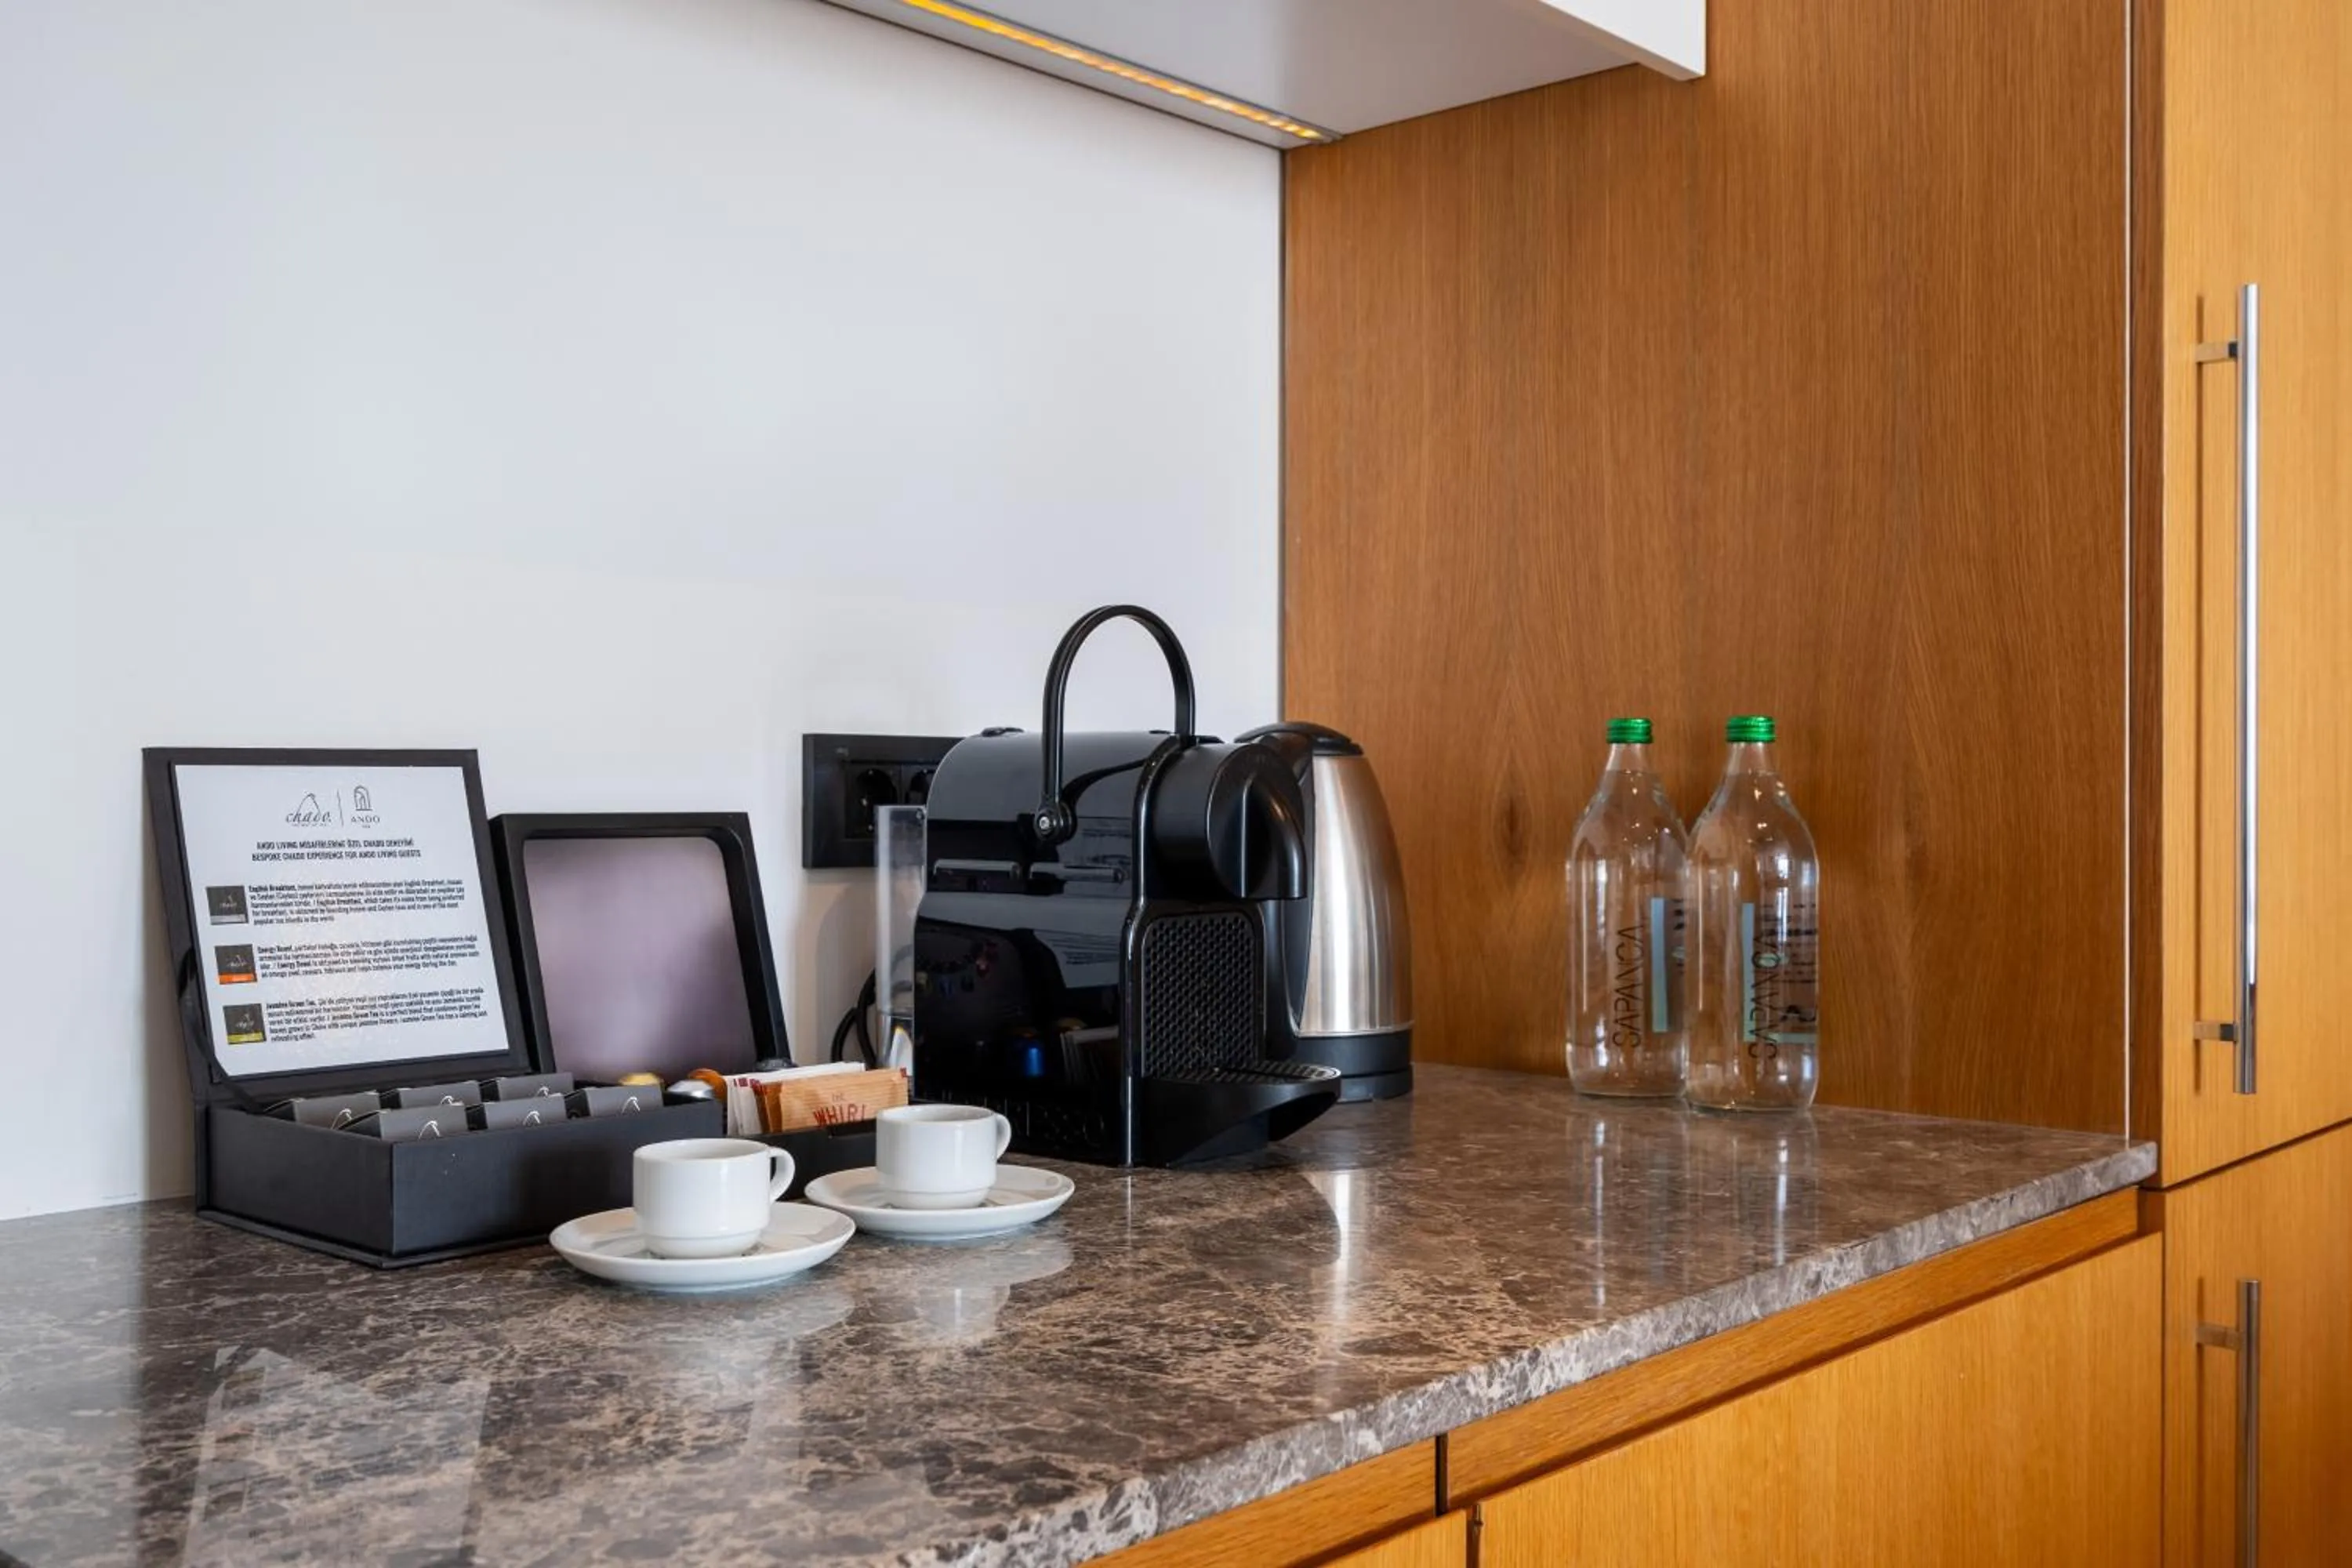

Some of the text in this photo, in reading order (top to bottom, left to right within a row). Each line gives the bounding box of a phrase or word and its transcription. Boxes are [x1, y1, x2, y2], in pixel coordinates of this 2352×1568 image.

[350, 815, 380, 823] ANDO
[345, 851, 358, 859] FOR
[1613, 924, 1644, 1048] SAPANCA
